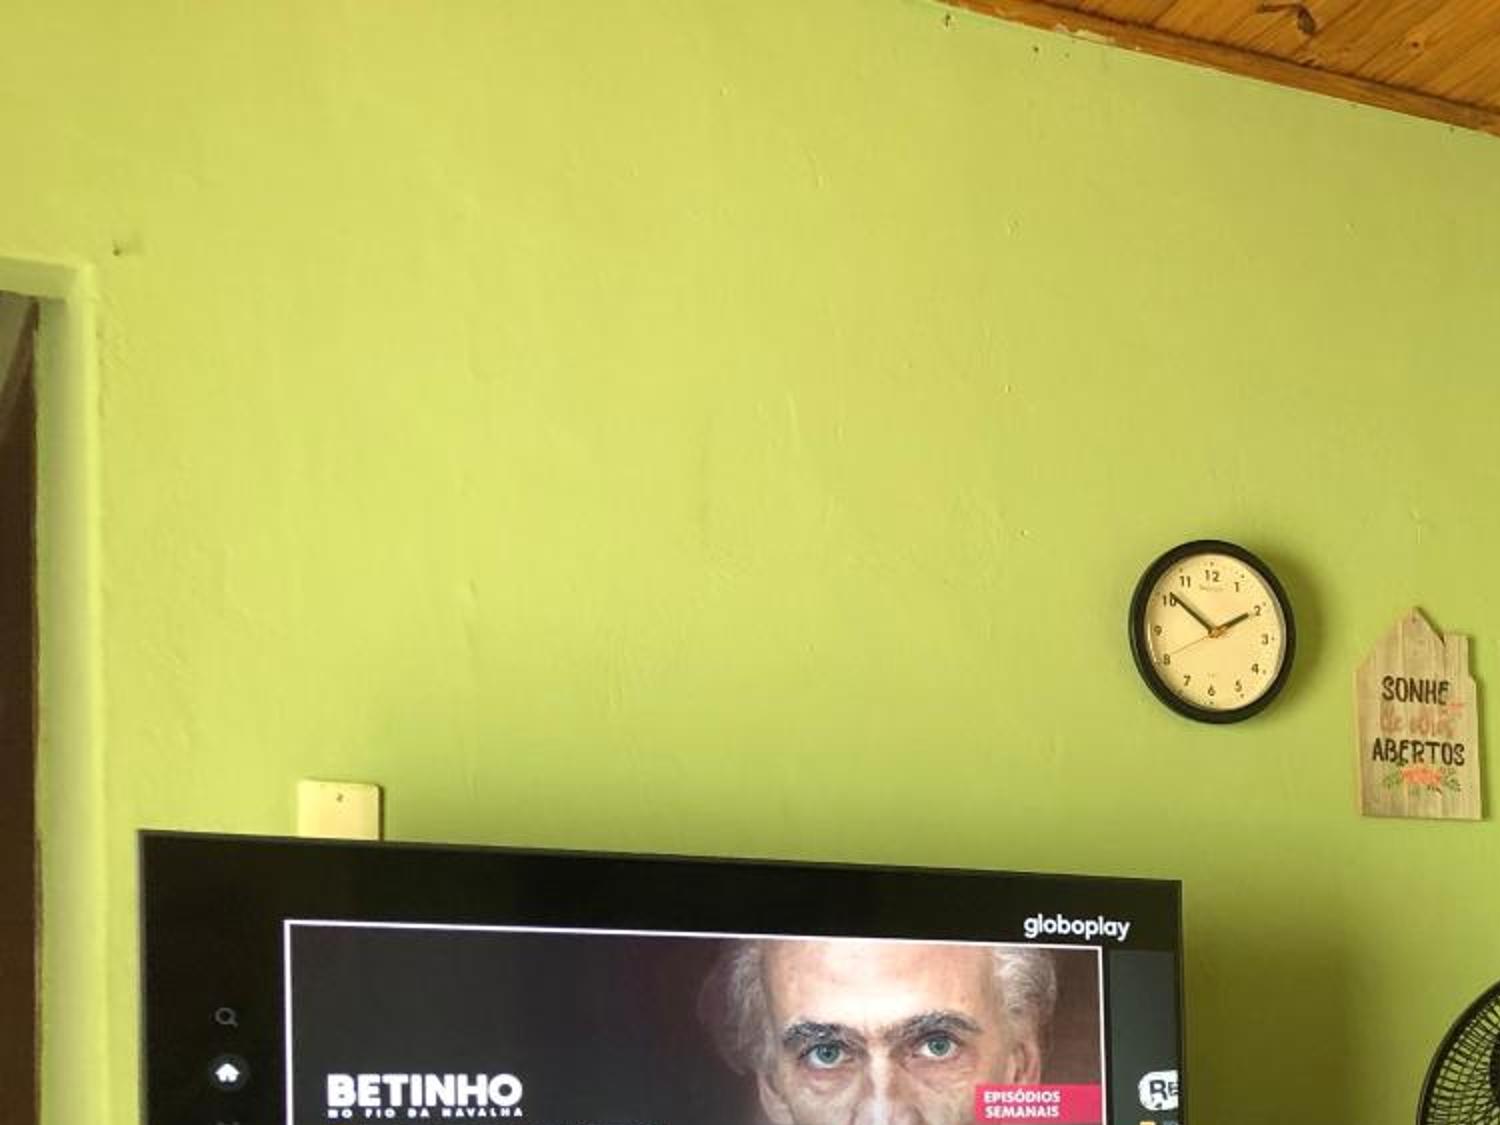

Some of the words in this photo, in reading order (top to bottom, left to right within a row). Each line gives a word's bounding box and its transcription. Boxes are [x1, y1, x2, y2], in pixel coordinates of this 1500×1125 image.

[1180, 576, 1191, 588] 11
[1204, 570, 1220, 582] 12
[1163, 594, 1177, 607] 10
[1253, 605, 1261, 616] 2
[1154, 625, 1162, 635] 9
[1261, 634, 1268, 645] 3
[1163, 654, 1170, 665] 8
[1251, 663, 1259, 674] 4
[1184, 675, 1191, 686] 7
[1235, 680, 1242, 692] 5
[1207, 684, 1216, 696] 6
[1381, 675, 1450, 706] SONHE
[1372, 737, 1465, 767] ABERTOS
[1023, 913, 1130, 941] globoplay
[327, 1073, 523, 1107] BETINHO
[983, 1087, 1061, 1103] EPISÓDIOS
[327, 1108, 352, 1119] NO
[364, 1107, 396, 1119] FIO
[407, 1107, 430, 1118] DA
[441, 1107, 523, 1118] NAVALHA
[985, 1105, 1060, 1119] SEMANAIS
